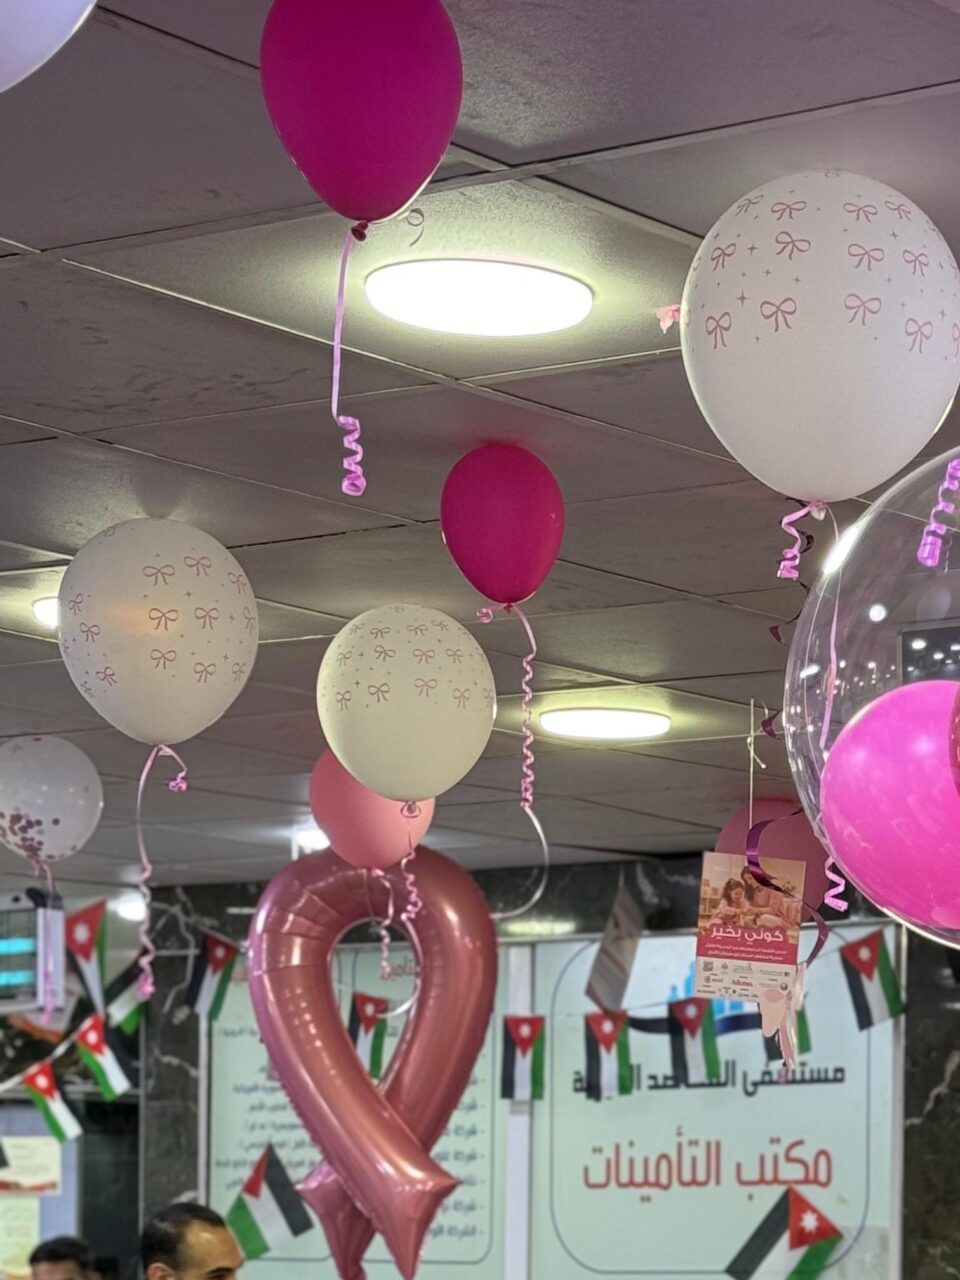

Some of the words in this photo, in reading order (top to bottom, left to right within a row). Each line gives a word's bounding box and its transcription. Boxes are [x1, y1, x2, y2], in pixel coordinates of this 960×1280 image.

[710, 925, 742, 942] بخير
[744, 927, 784, 945] كوني
[583, 1125, 721, 1203] التأمينات
[735, 1136, 833, 1202] مكتب
